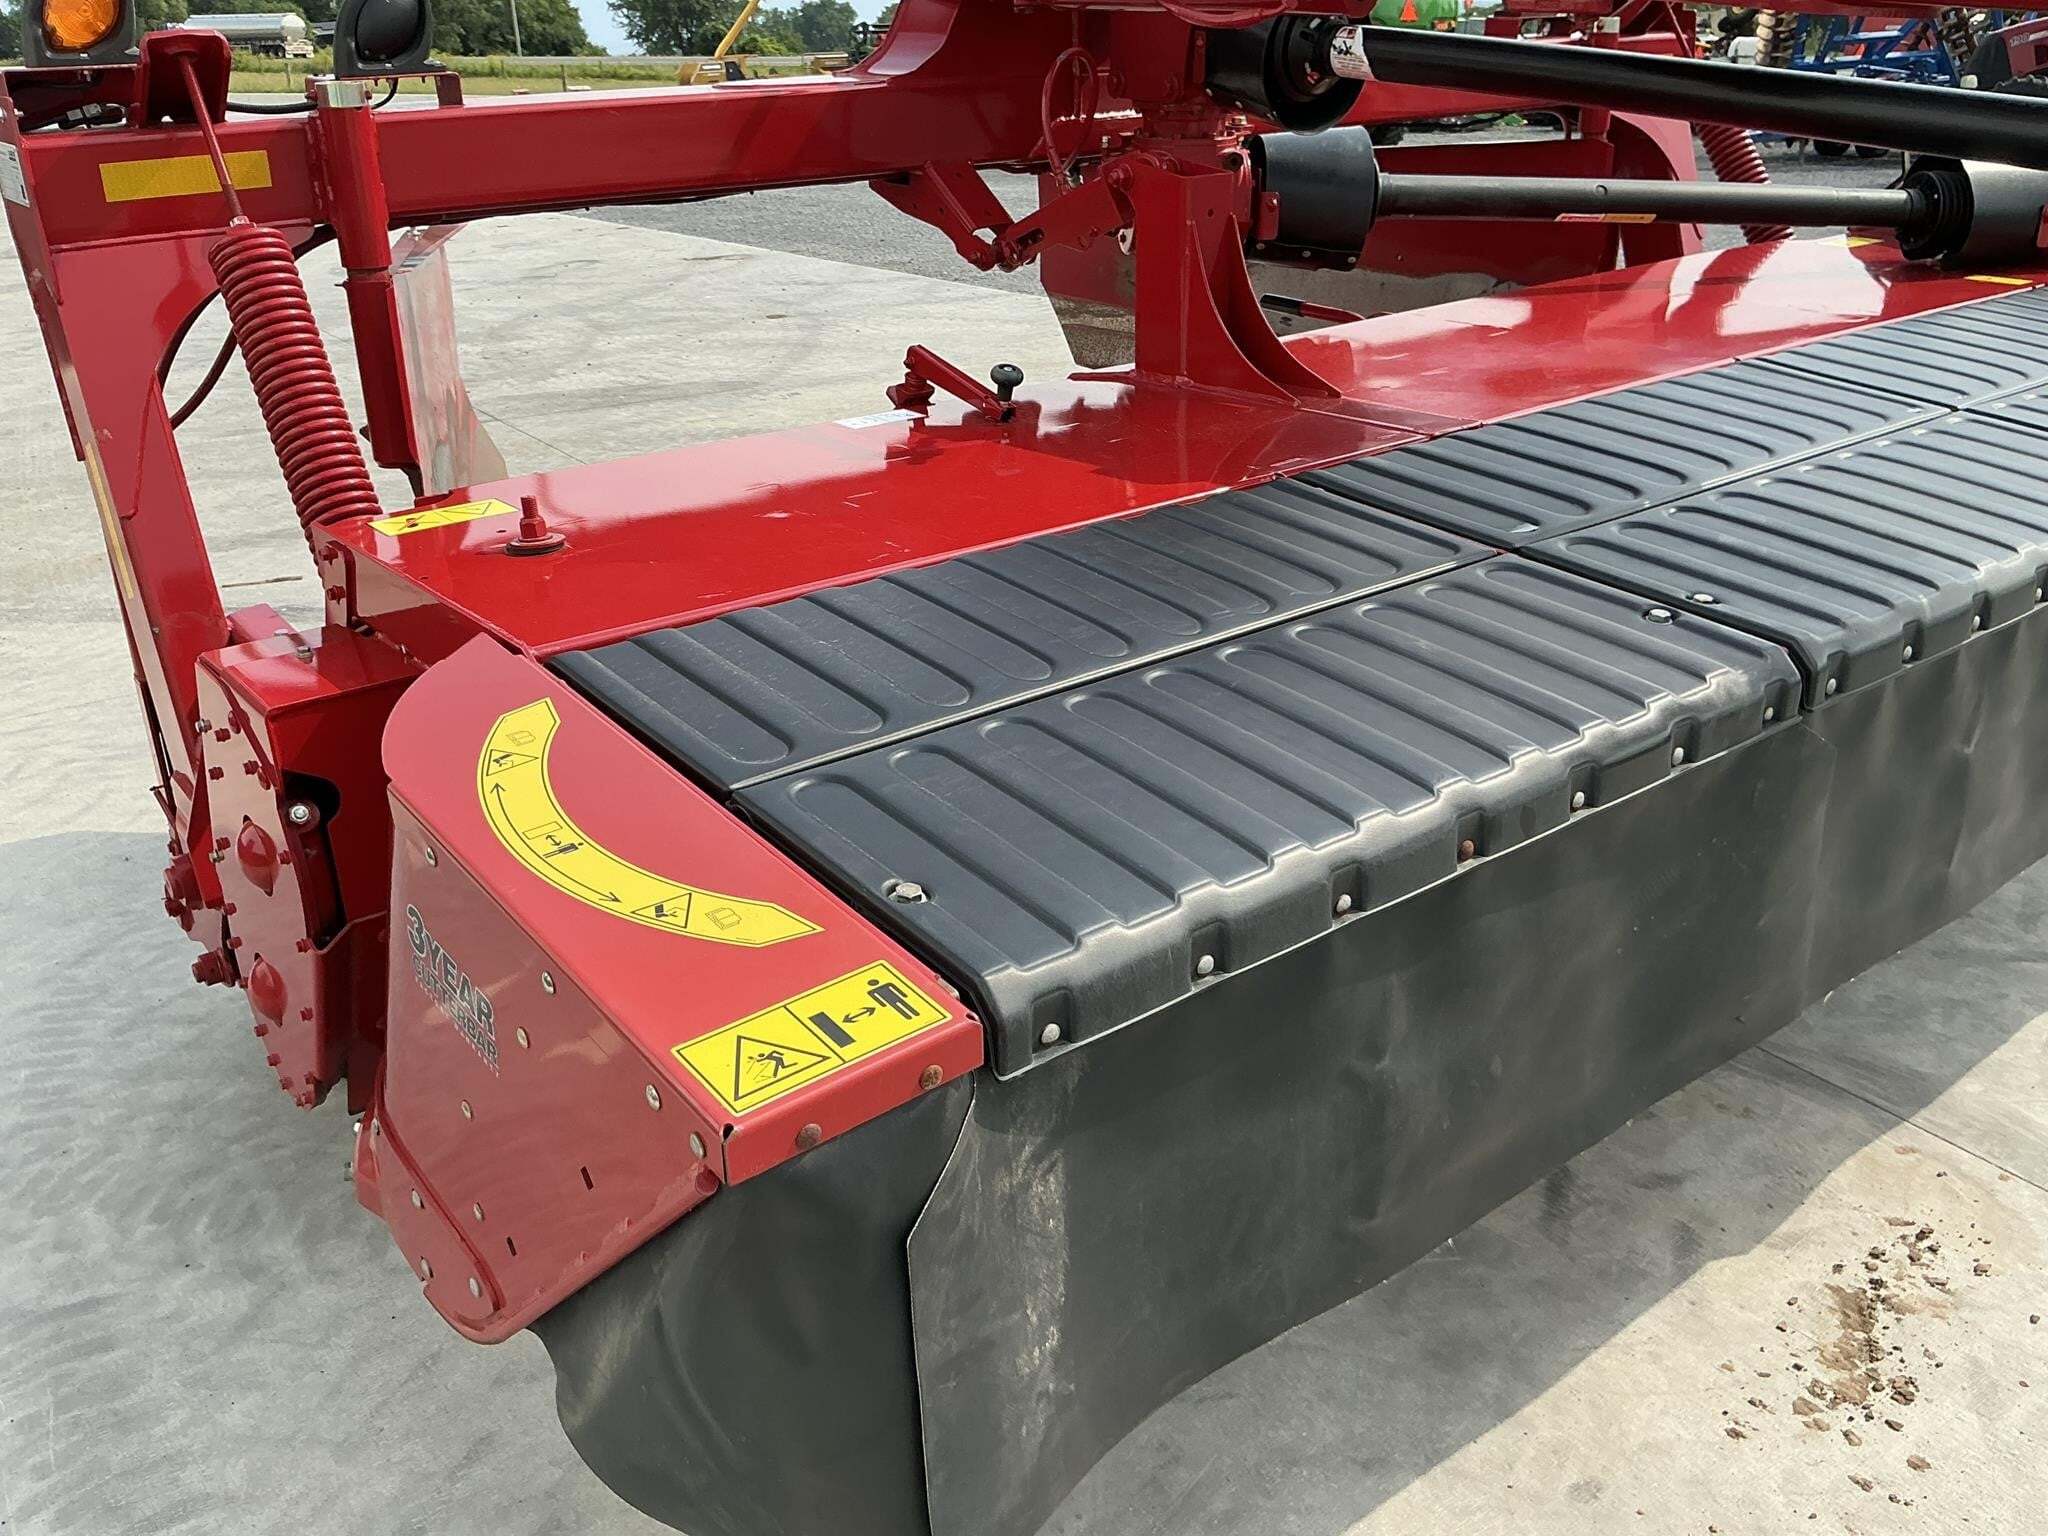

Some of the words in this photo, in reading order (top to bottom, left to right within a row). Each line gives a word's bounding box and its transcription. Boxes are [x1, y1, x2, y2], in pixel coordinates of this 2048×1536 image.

[406, 904, 427, 957] 3
[424, 930, 496, 1041] YEAR
[412, 953, 500, 1070] CUTTERBAR
